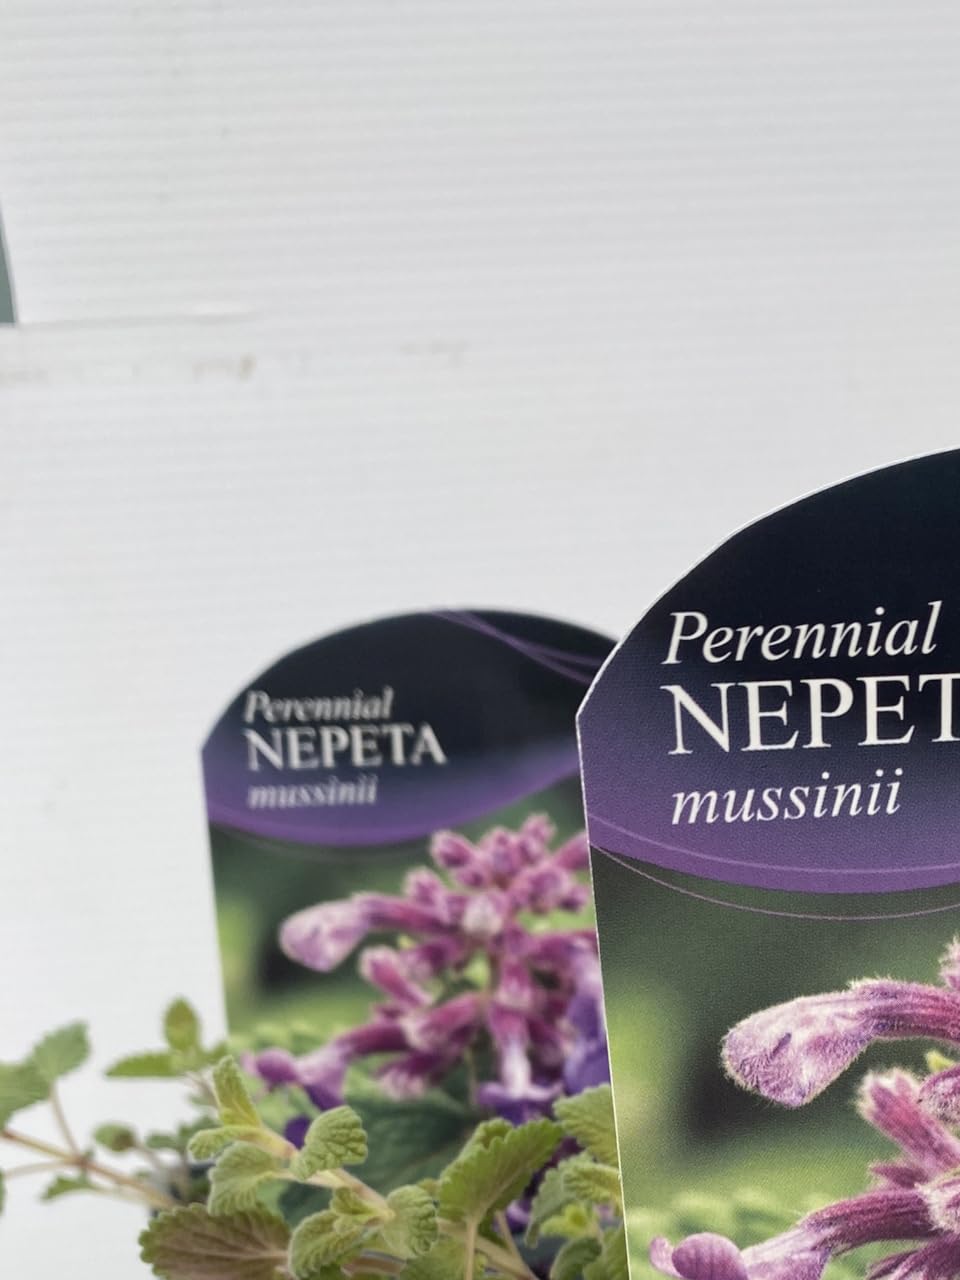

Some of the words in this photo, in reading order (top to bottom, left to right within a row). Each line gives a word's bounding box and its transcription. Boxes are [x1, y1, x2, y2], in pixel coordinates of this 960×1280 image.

[660, 600, 943, 665] Perennial
[243, 685, 395, 723] Perennial
[244, 721, 448, 771] NEPETA
[672, 768, 904, 825] mussinii
